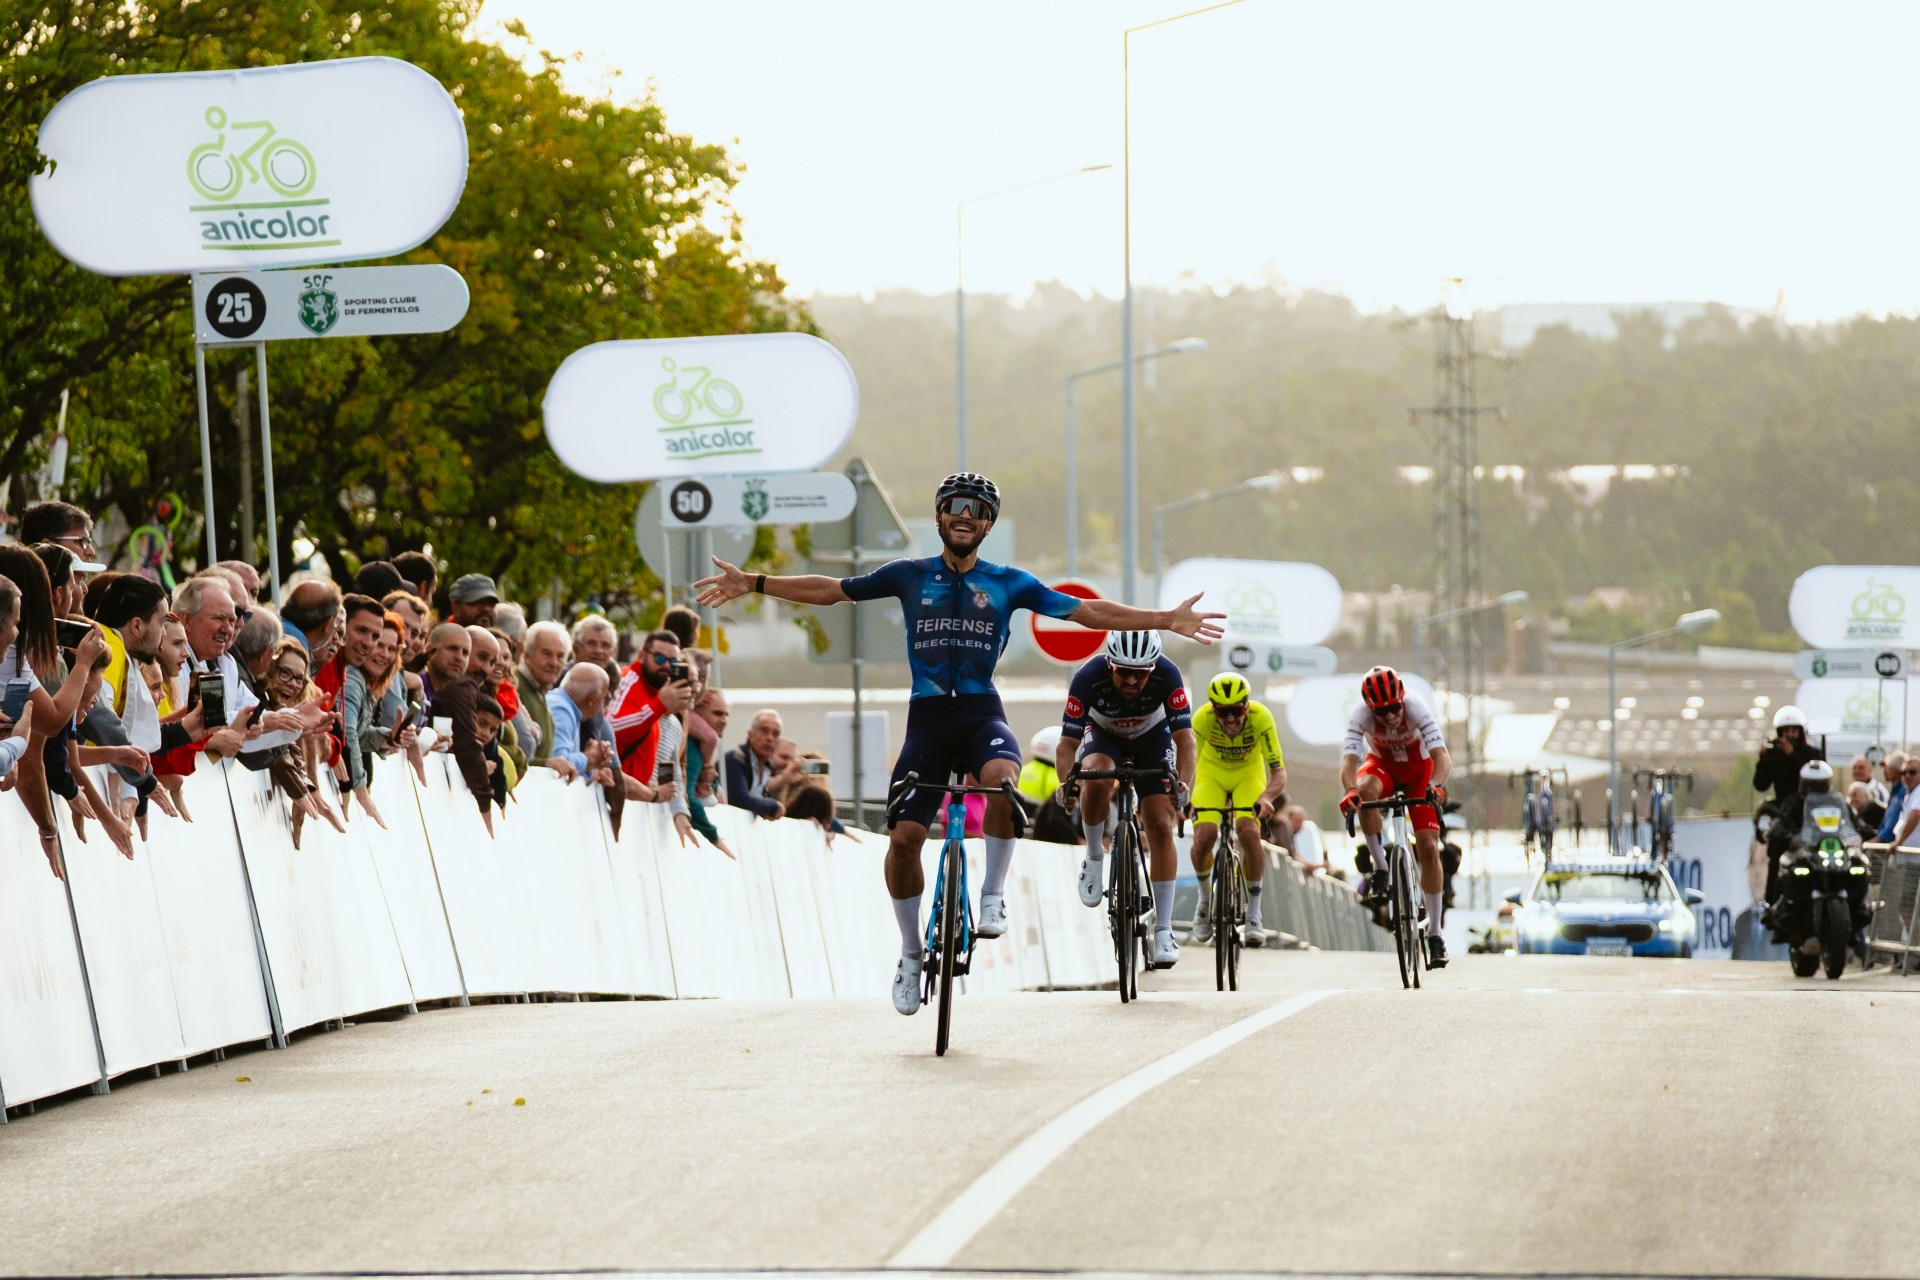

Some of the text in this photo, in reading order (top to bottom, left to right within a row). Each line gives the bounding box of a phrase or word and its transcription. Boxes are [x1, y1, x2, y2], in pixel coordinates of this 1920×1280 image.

[200, 210, 330, 241] anicolor
[303, 274, 333, 289] SCF
[217, 292, 253, 324] 25
[344, 296, 417, 306] SPORTING CLUBE
[344, 306, 420, 316] DE FERMENTELOS
[665, 427, 755, 453] anicolor
[676, 489, 705, 514] 50
[916, 618, 994, 635] FEIRENSE
[1066, 701, 1081, 713] RP
[1173, 693, 1185, 705] RP
